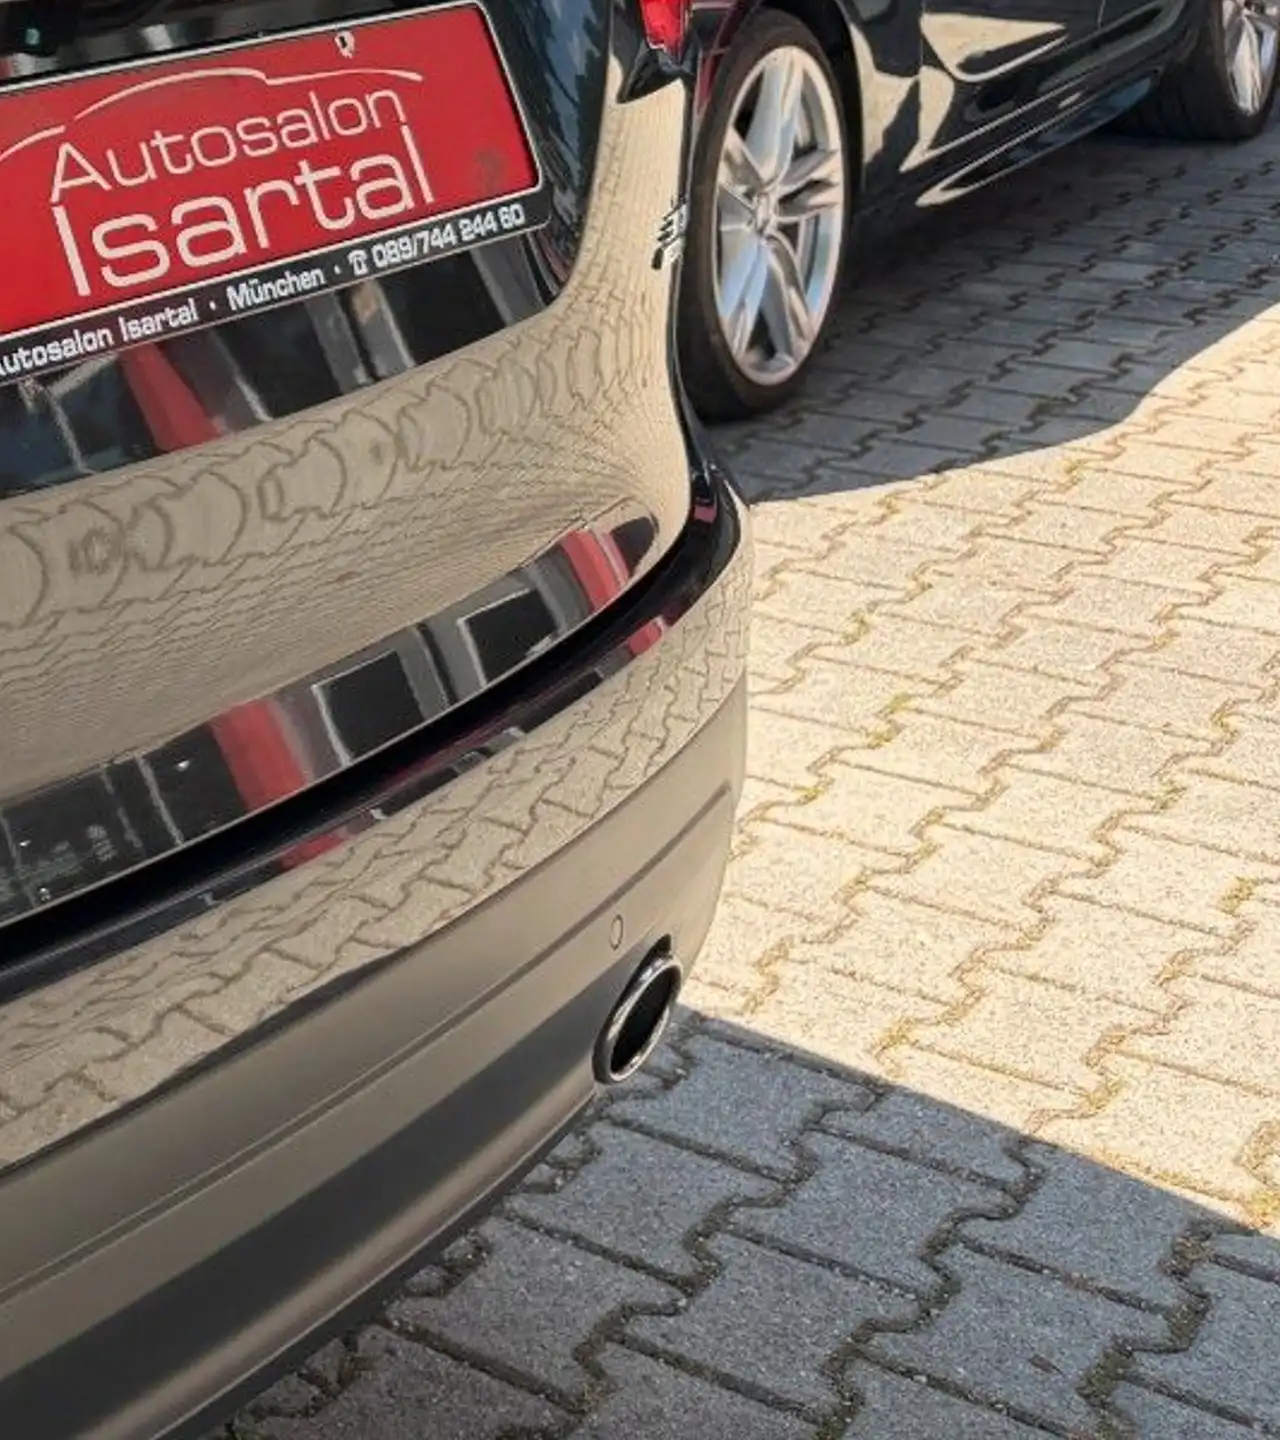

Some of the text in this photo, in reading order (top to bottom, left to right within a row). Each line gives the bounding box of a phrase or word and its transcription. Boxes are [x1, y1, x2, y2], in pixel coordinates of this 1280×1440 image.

[49, 87, 407, 204] Autosalon
[50, 123, 435, 297] Isartal
[119, 298, 200, 343] Isartal
[226, 266, 326, 311] München
[372, 227, 458, 267] 089/744
[460, 212, 497, 242] 244
